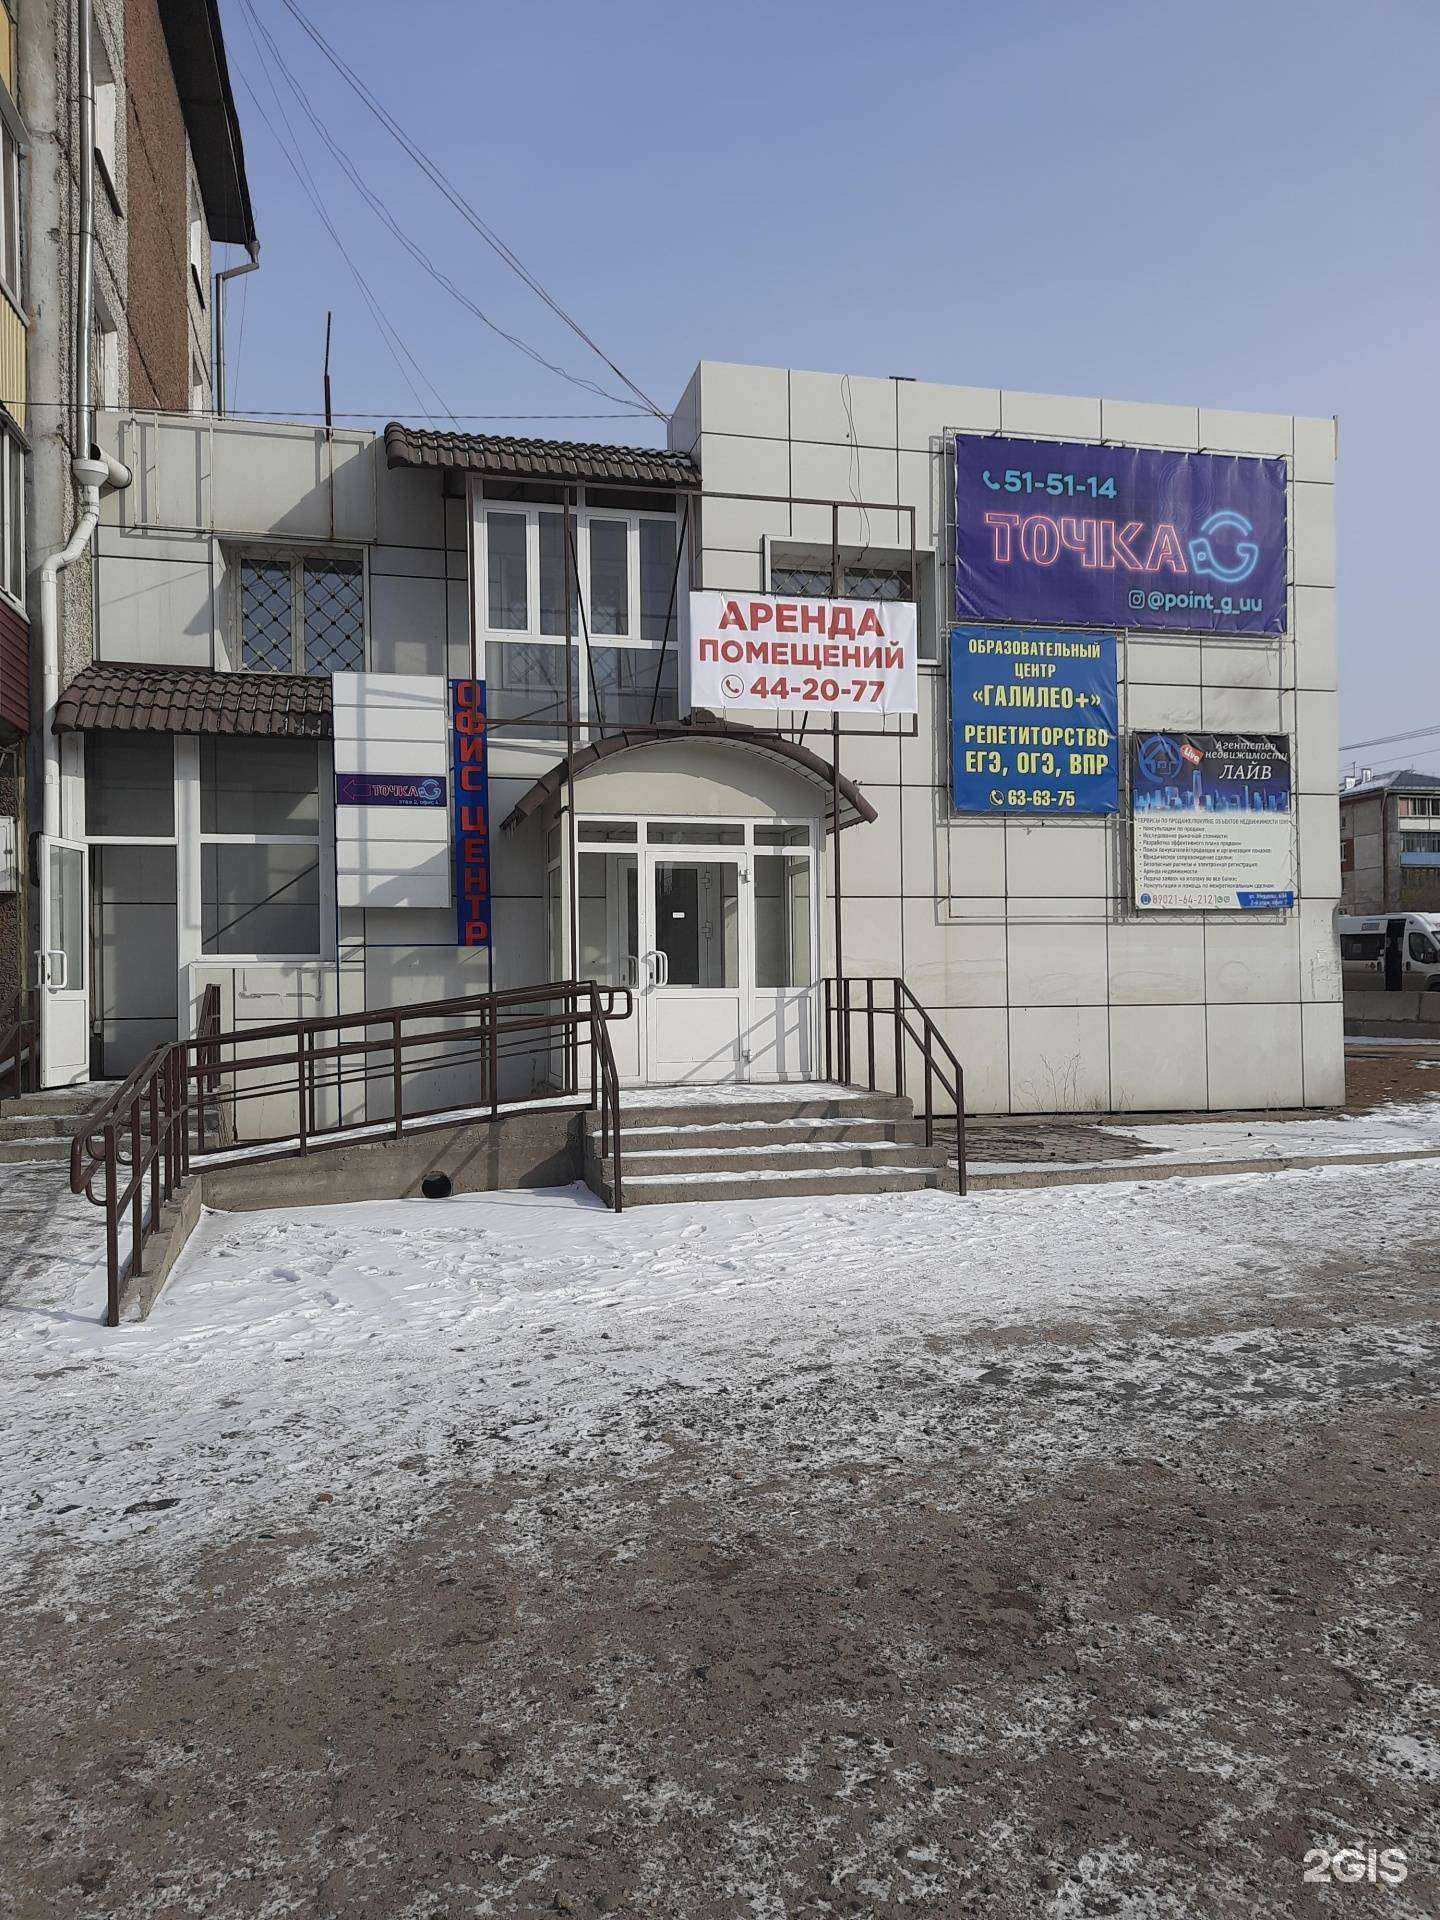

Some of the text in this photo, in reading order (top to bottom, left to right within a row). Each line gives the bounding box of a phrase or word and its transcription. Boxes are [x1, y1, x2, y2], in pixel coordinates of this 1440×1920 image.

[1004, 470, 1117, 499] 51-51-14
[984, 512, 1188, 573] ТОЧКА
[1148, 589, 1263, 615] @point_g_uu
[719, 601, 885, 641] АРЕНДА
[699, 639, 904, 670] ПОМЕЩЕНИЙ
[968, 638, 1101, 658] ОБРАЗОВАТЕЛЬНЫЙ
[1014, 662, 1056, 680] ЦЕНТР
[750, 677, 885, 702] 44-20-77
[972, 684, 1101, 709] «ГАЛИЛЕО+»
[964, 724, 1109, 747] РЕПЕТИТОРСТВО
[1215, 740, 1277, 752] Агентство
[965, 751, 1109, 778] ЕГЭ, ОГЭ, ВПР
[1205, 750, 1289, 762] недвижимости
[1219, 760, 1273, 780] ЛАЙВ
[372, 784, 419, 797] ТОЧКА
[1007, 789, 1076, 807] 63-63-75
[455, 681, 488, 947] ОФИС ЦЕНТР
